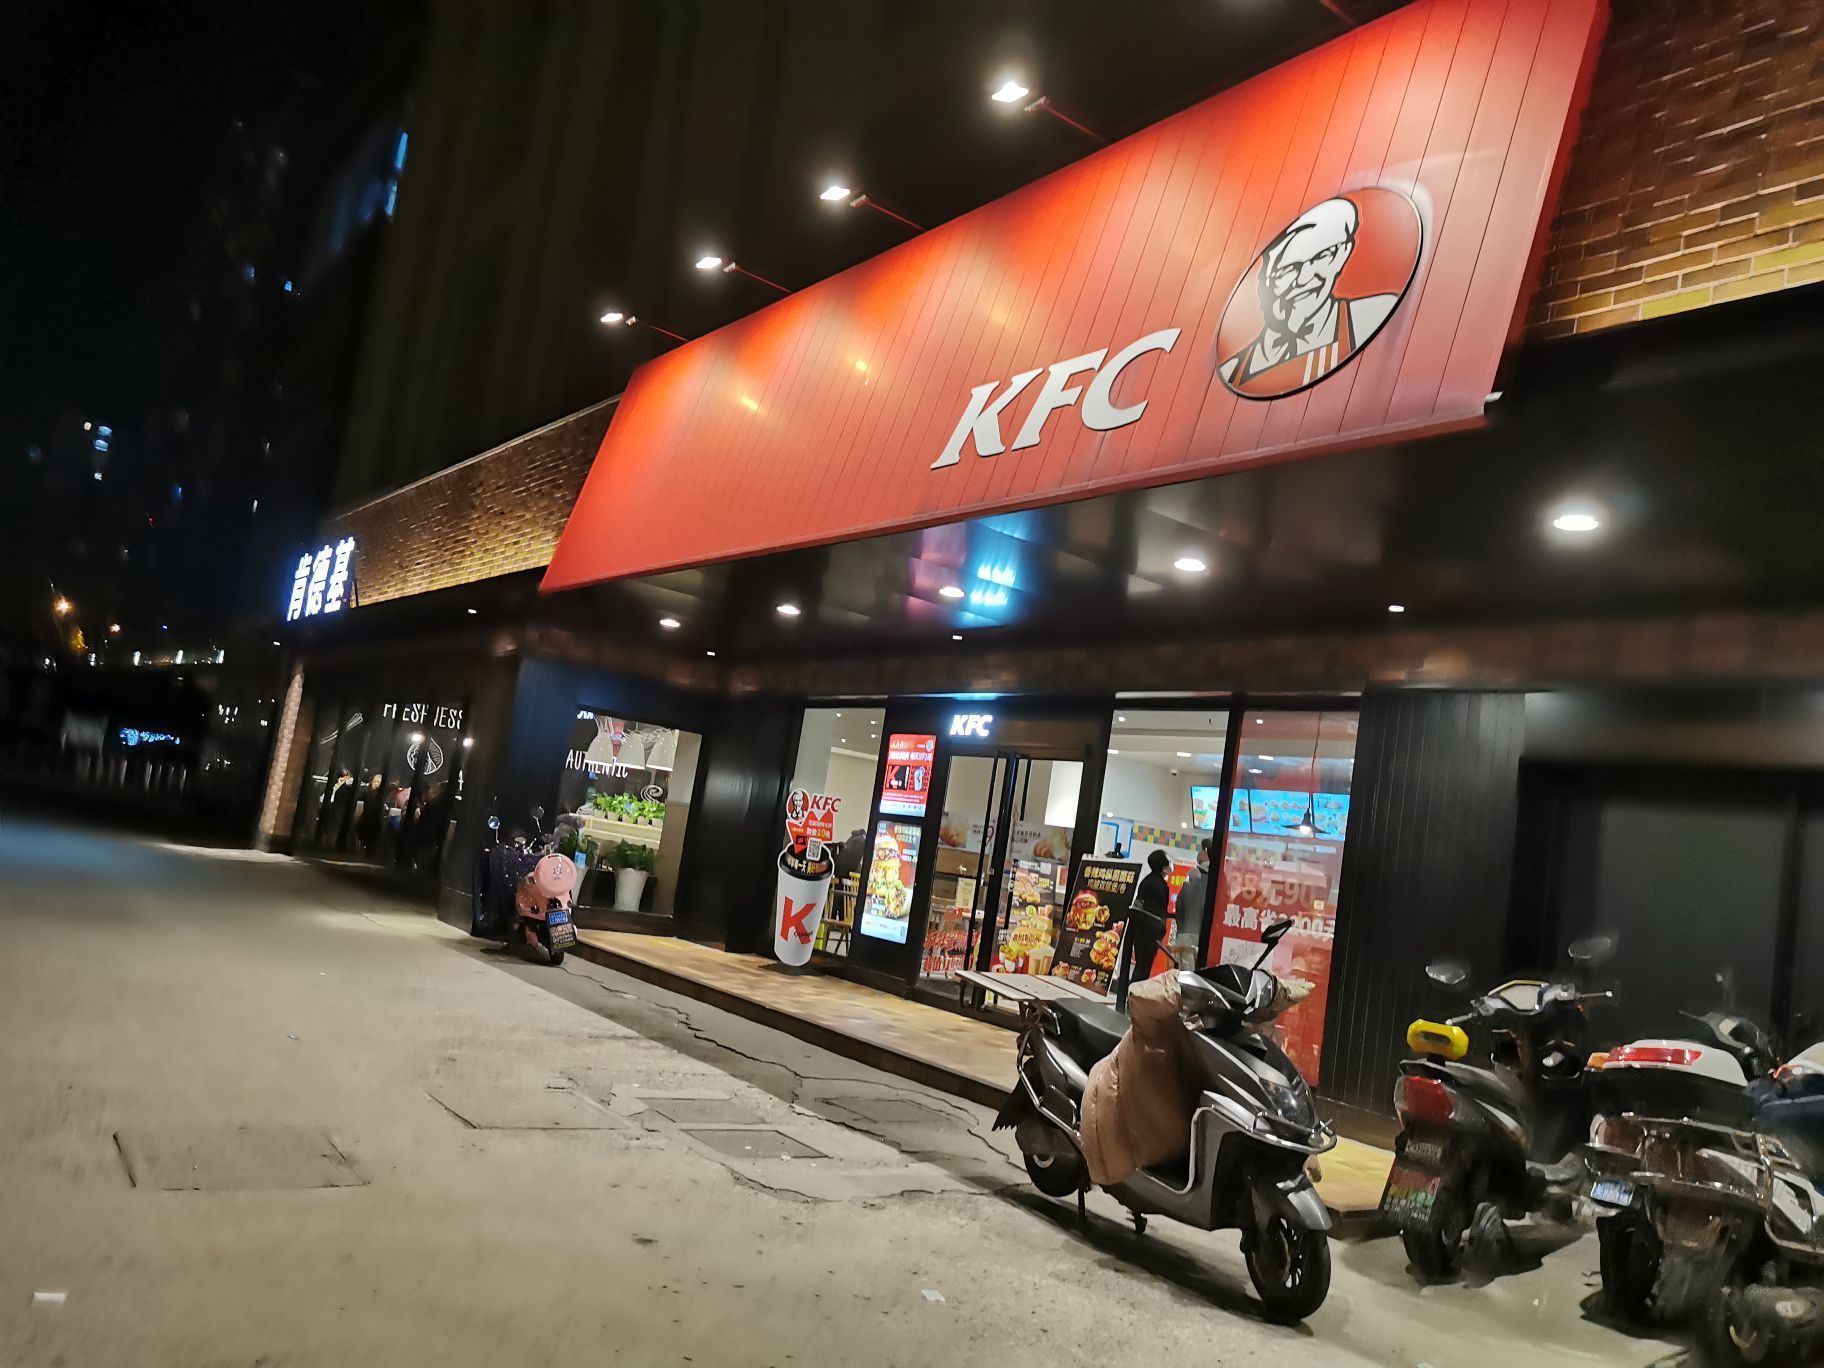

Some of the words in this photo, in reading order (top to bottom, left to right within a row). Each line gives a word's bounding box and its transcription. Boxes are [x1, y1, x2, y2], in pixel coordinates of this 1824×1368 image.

[930, 328, 1182, 471] KFC
[286, 536, 356, 622] 肯德基
[949, 714, 993, 737] KFC
[810, 794, 842, 813] KFC
[780, 895, 818, 945] K
